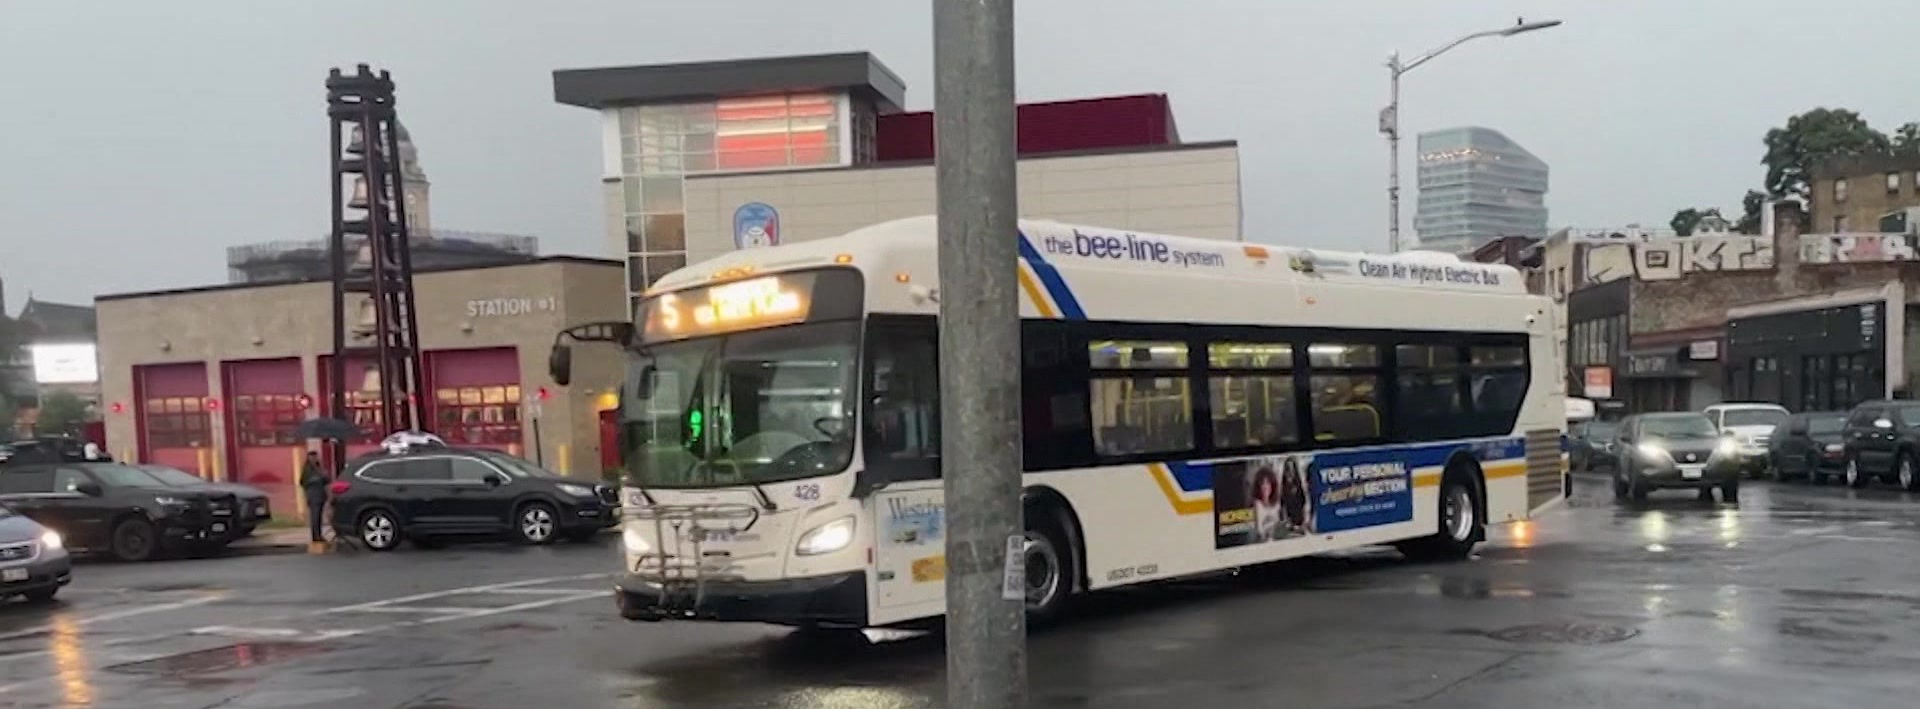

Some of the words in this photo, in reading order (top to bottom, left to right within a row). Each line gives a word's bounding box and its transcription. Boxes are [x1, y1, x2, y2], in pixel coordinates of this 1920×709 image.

[1045, 236, 1072, 255] the
[1172, 249, 1225, 268] system
[1359, 258, 1390, 277] Clean
[1392, 262, 1406, 279] Air
[1409, 264, 1443, 284] Hybrid
[1445, 266, 1480, 284] Electric
[1483, 270, 1499, 285] Bus
[467, 299, 531, 316] STATION
[1319, 466, 1351, 484] YOUR
[1352, 461, 1406, 480] PERSONAL
[795, 484, 820, 501] 428
[1363, 478, 1407, 498] SECTION
